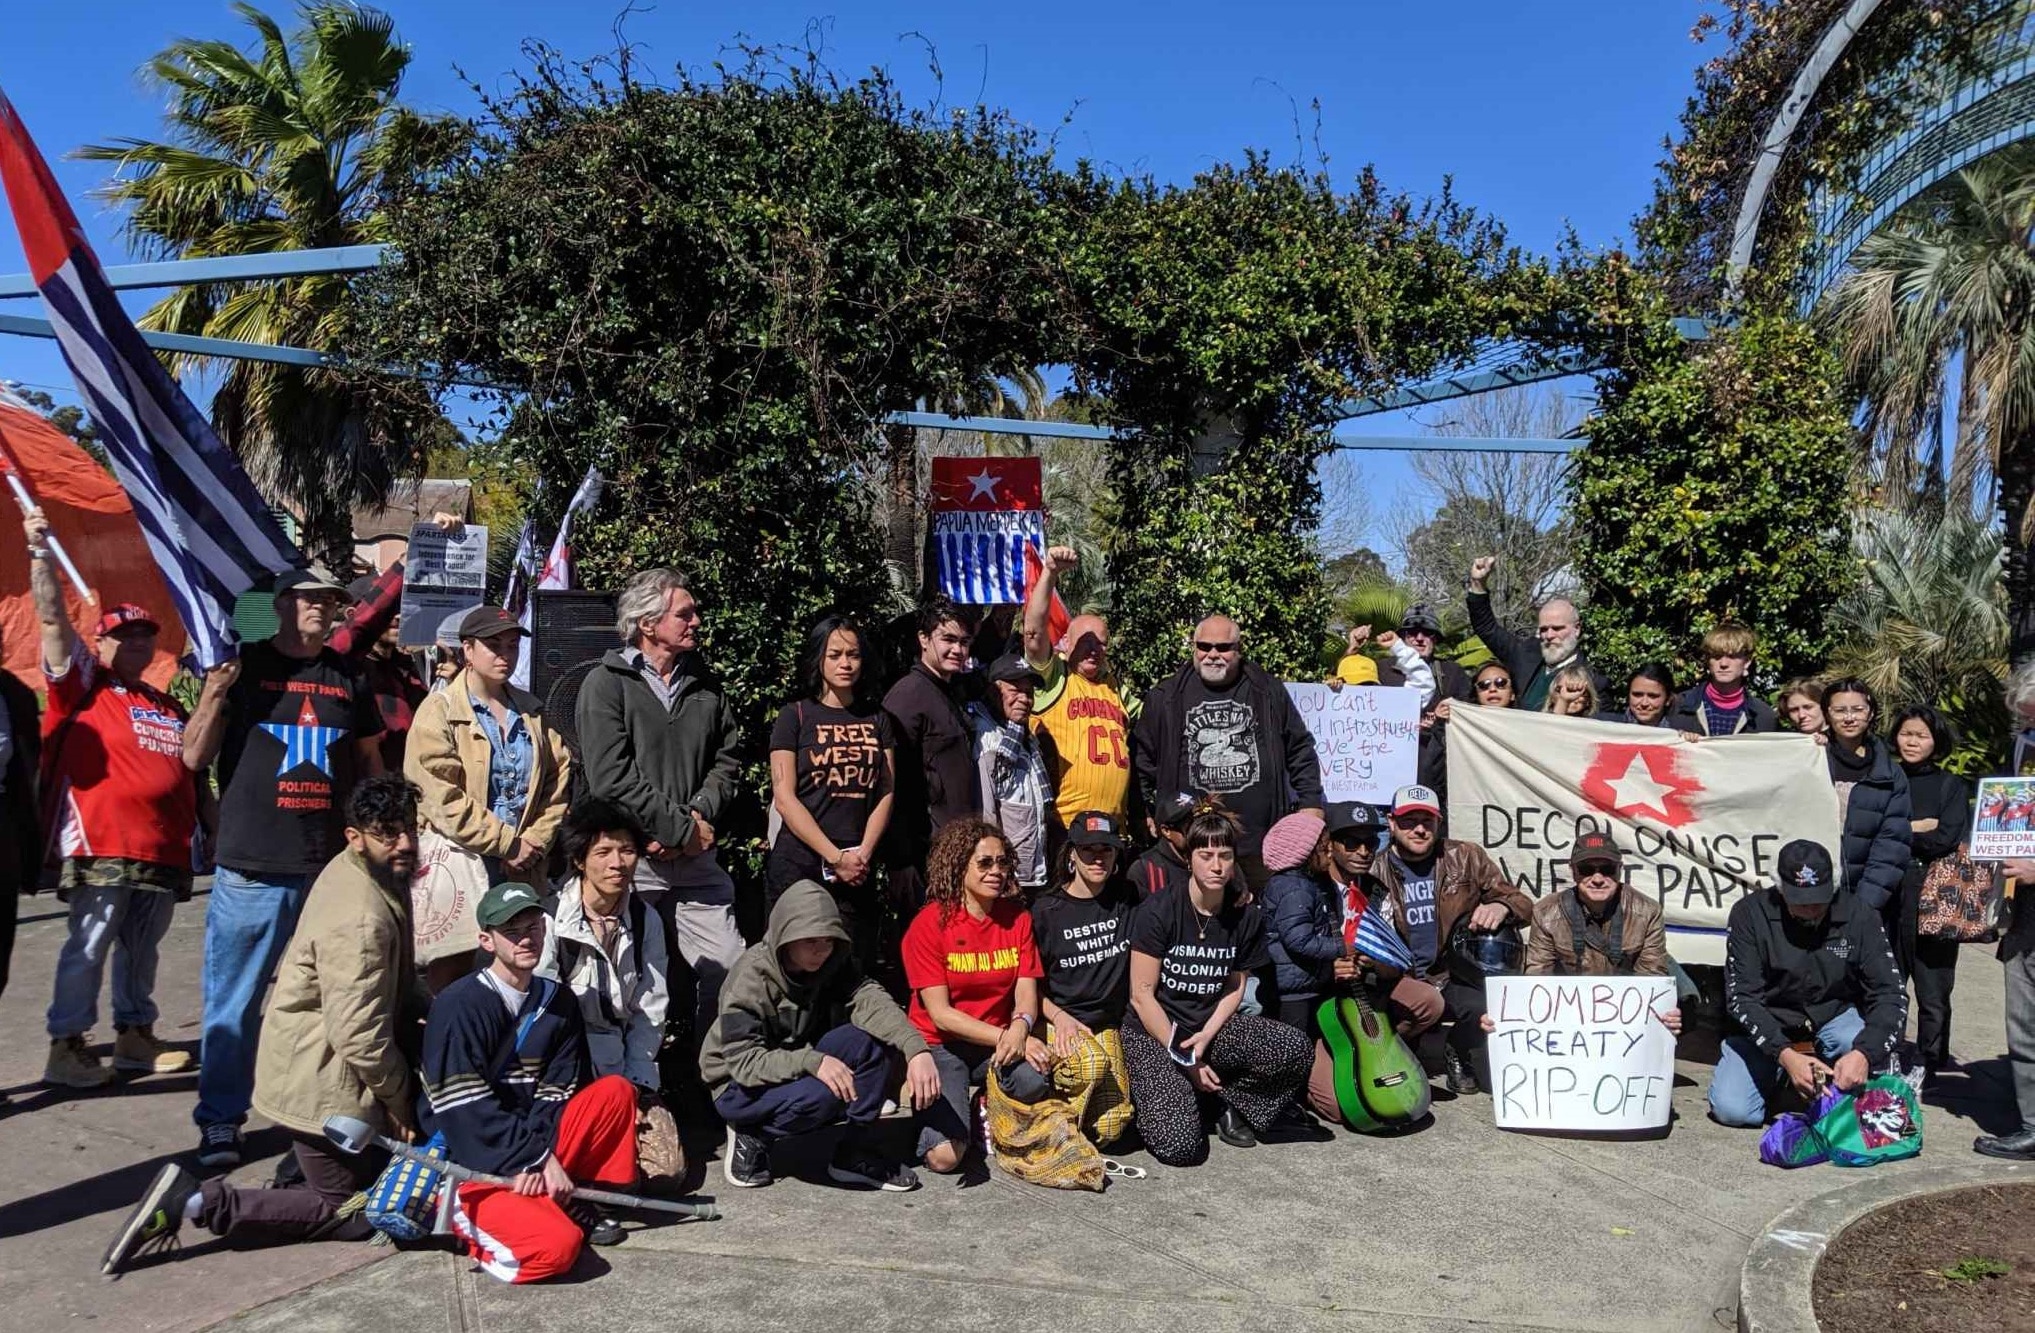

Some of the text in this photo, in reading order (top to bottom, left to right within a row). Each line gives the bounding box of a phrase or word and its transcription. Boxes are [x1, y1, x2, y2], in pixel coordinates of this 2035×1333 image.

[933, 511, 1040, 535] PAPUA MERDEKA
[287, 682, 317, 694] WEST
[1331, 691, 1378, 713] can't
[816, 723, 879, 745] FREE
[809, 745, 879, 766] WEST
[1087, 725, 1129, 769] CC
[1357, 739, 1394, 756] the
[1200, 765, 1250, 780] WHISKEY
[278, 781, 332, 793] POLITICAL
[1975, 845, 2012, 855] WEST
[1498, 856, 1644, 899] WET
[1162, 957, 1231, 977] COLONIAL
[1500, 983, 1672, 1026] LOMBOK
[1498, 1028, 1645, 1058] TREATY
[1501, 1063, 1664, 1119] RIP-OFF
